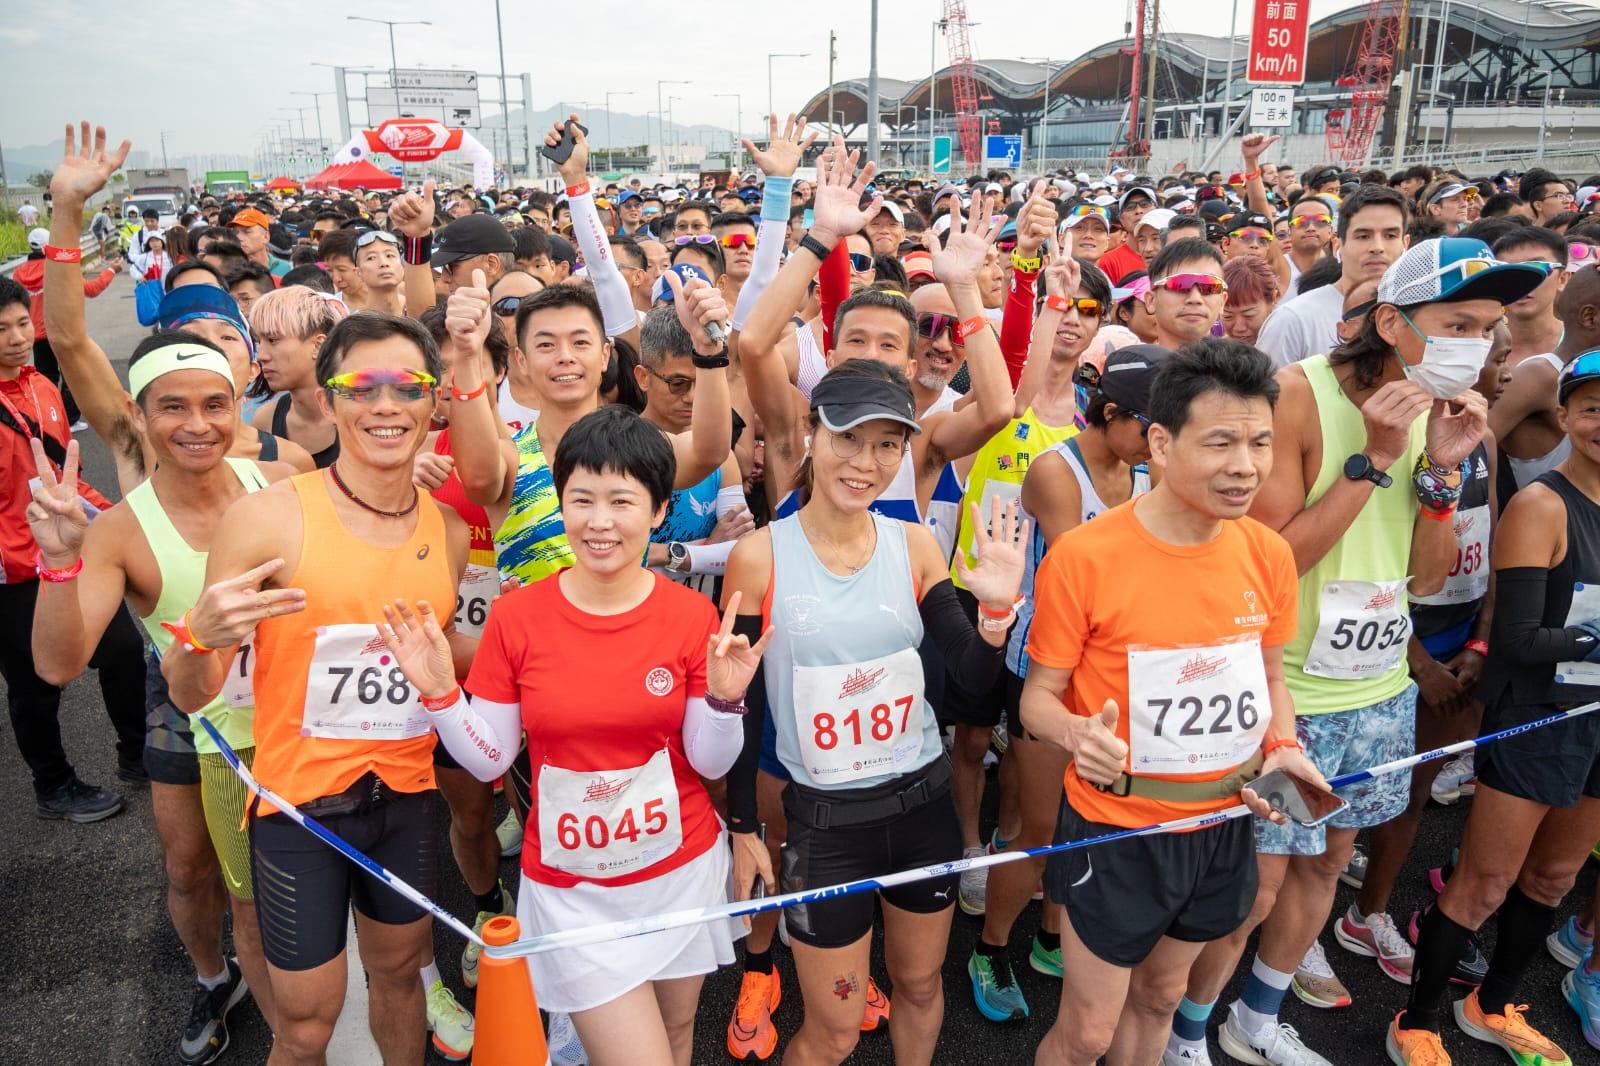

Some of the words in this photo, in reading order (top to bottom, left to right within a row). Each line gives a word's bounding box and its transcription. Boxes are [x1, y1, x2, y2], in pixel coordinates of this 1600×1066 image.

[1266, 1, 1298, 21] 前面
[1267, 27, 1291, 48] 50
[1255, 52, 1298, 76] km/h
[1260, 92, 1276, 103] 100
[1278, 94, 1286, 103] m
[1254, 107, 1289, 121] 一百米
[1330, 614, 1408, 651] 5052
[327, 666, 423, 705] 768
[813, 694, 914, 751] 8187
[1147, 690, 1259, 737] 7226
[557, 797, 668, 850] 6045
